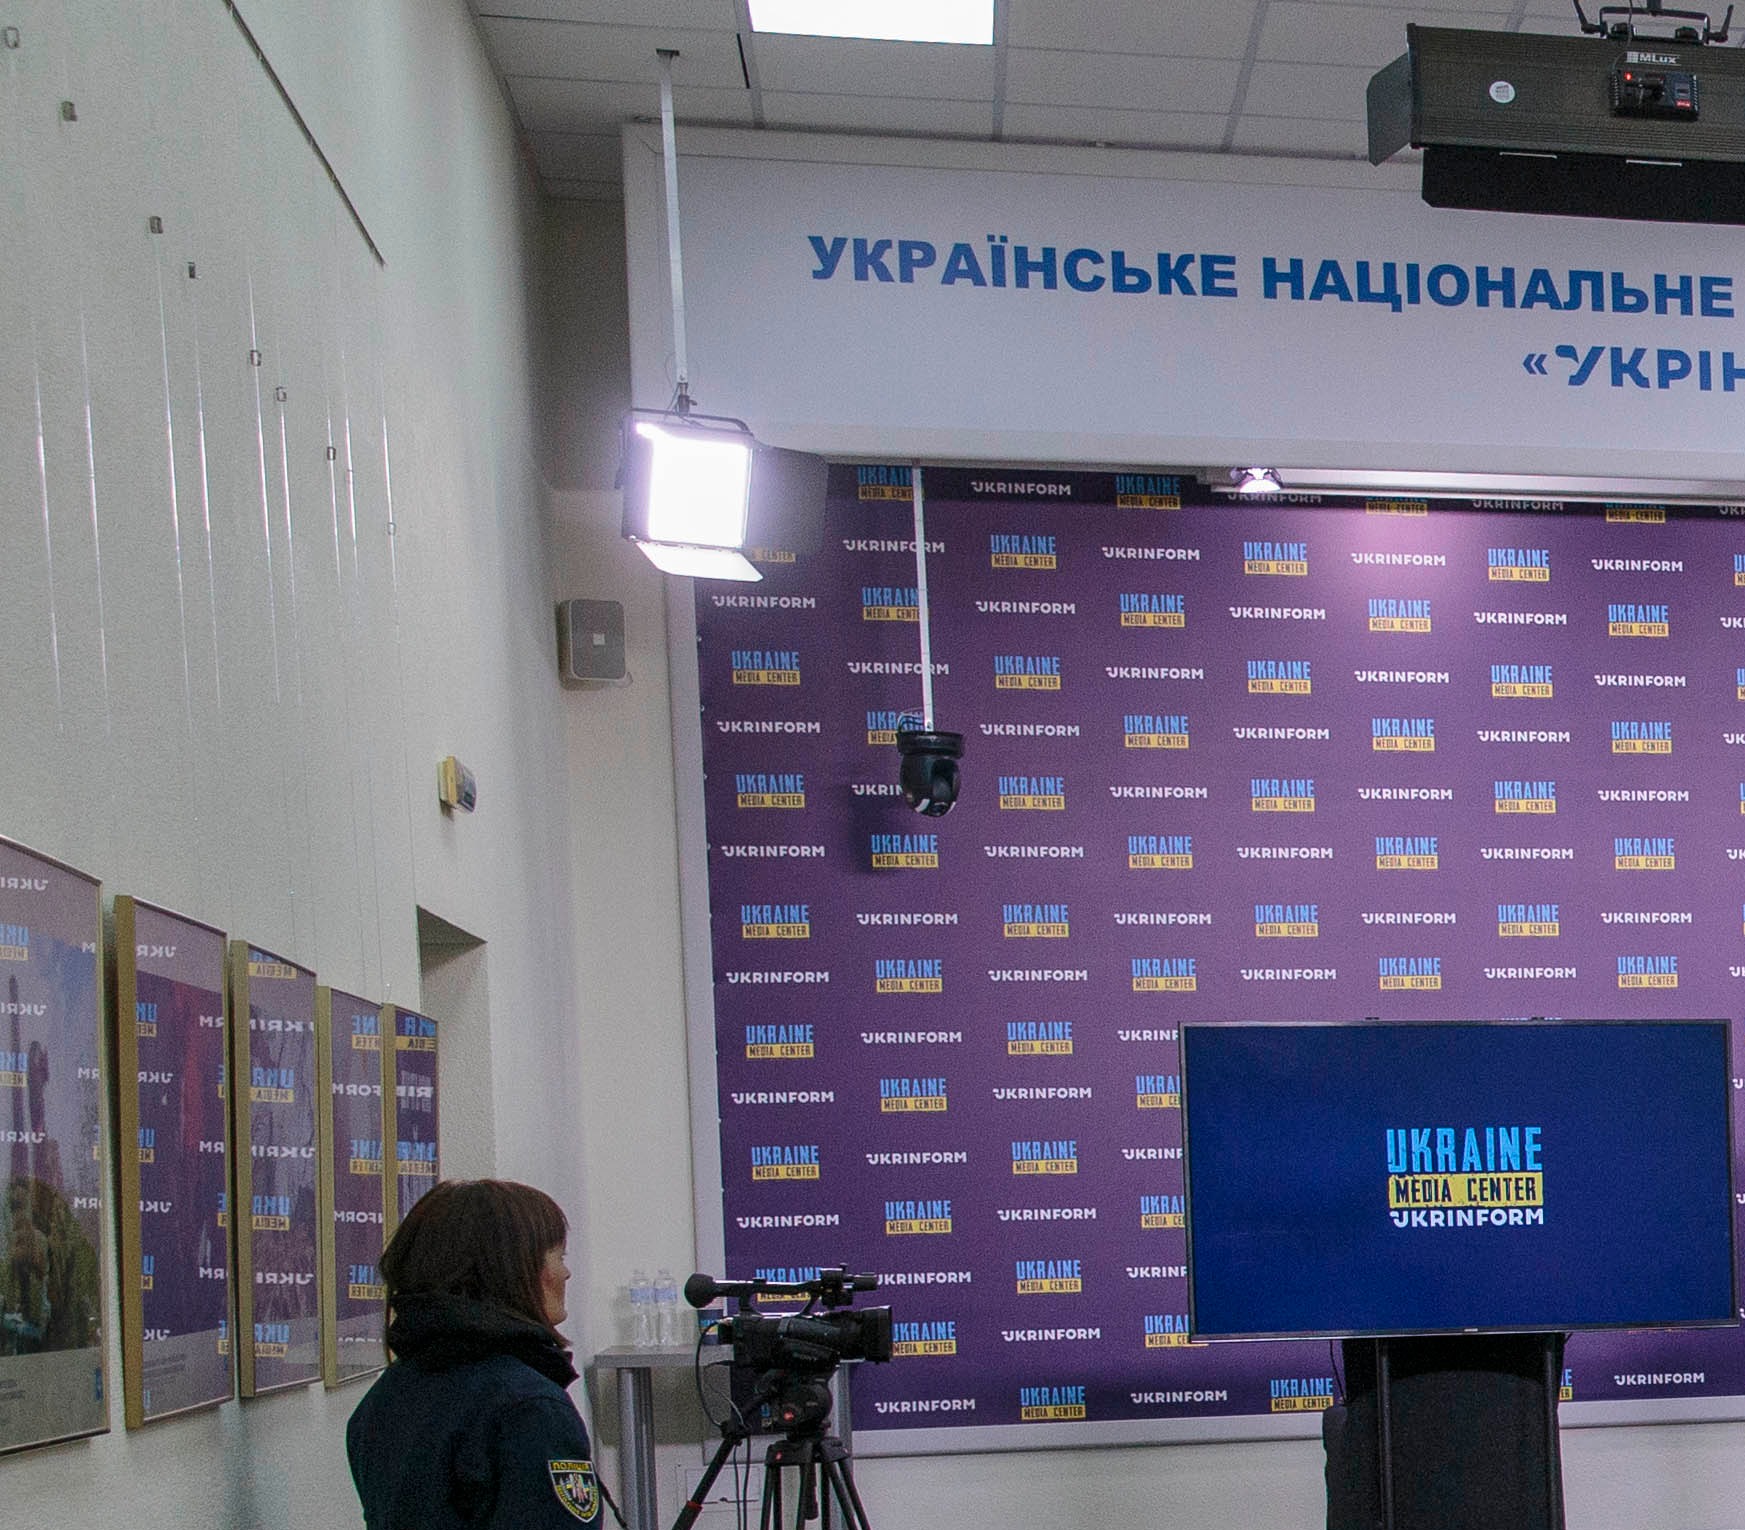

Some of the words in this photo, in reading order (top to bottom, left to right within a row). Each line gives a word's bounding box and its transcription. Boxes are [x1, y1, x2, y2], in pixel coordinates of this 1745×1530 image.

[808, 234, 1238, 298] УКРАЇНСЬКЕ
[1262, 256, 1734, 318] НАЦІОНАЛЬНЕ
[972, 482, 1070, 494] UKRINFORM
[992, 536, 1055, 552] UKRAINE
[1245, 543, 1306, 558] UKRAINE
[993, 552, 1018, 566] MEDIA
[1024, 553, 1054, 567] CENTER
[1102, 547, 1200, 560] UKRINFORM
[1352, 553, 1445, 565] UKRINFORM
[1491, 550, 1548, 564] UKRAINE
[1246, 558, 1270, 572] MEDIA
[1276, 559, 1305, 573] CENTER
[1491, 565, 1514, 579] MEDIA
[1519, 565, 1547, 580] CENTER
[712, 597, 815, 608] UKRINFORM
[976, 601, 1075, 614] UKRINFORM
[1229, 607, 1325, 619] UKRINFORM
[1474, 612, 1567, 624] UKRINFORM
[732, 652, 799, 668] UKRAINE
[735, 668, 761, 682] MEDIA
[766, 669, 798, 683] CENTER
[1106, 667, 1203, 679] UKRINFORM
[1594, 675, 1686, 686] UKRINFORM
[717, 721, 820, 733] UKRINFORM
[980, 724, 1080, 736] UKRINFORM
[1233, 728, 1329, 739] UKRINFORM
[1000, 778, 1064, 793] UKRAINE
[1253, 780, 1314, 795] UKRAINE
[1110, 787, 1207, 798] UKRINFORM
[1358, 788, 1452, 800] UKRINFORM
[1002, 793, 1027, 807] MEDIA
[1032, 794, 1063, 808] CENTER
[1254, 795, 1278, 809] MEDIA
[1284, 796, 1313, 810] CENTER
[721, 845, 825, 857] UKRINFORM
[984, 846, 1083, 857] UKRINFORM
[1617, 839, 1674, 852] UKRAINE
[1237, 847, 1333, 858] UKRINFORM
[1481, 848, 1573, 859] UKRINFORM
[1617, 853, 1640, 867] MEDIA
[1645, 853, 1673, 868] CENTER
[742, 905, 809, 923] UKRAINE
[856, 913, 958, 925] UKRINFORM
[1114, 913, 1211, 924] UKRINFORM
[1362, 913, 1456, 924] UKRINFORM
[1601, 912, 1692, 923] UKRINFORM
[744, 923, 770, 936] MEDIA
[776, 924, 808, 936] CENTER
[1380, 959, 1440, 974] UKRAINE
[1484, 967, 1576, 978] UKRINFORM
[726, 971, 829, 984] UKRINFORM
[988, 970, 1087, 981] UKRINFORM
[1241, 969, 1336, 980] UKRINFORM
[1382, 974, 1405, 988] MEDIA
[1410, 975, 1439, 988] CENTER
[1008, 1022, 1072, 1038] UKRAINE
[861, 1032, 962, 1044] UKRINFORM
[1010, 1038, 1035, 1052] MEDIA
[1040, 1039, 1071, 1053] CENTER
[731, 1091, 834, 1104] UKRINFORM
[752, 1146, 819, 1163] UKRAINE
[1386, 1127, 1543, 1173] UKRAINE
[866, 1152, 967, 1165] UKRINFORM
[754, 1163, 780, 1177] MEDIA
[786, 1164, 818, 1178] CENTER
[1395, 1179, 1452, 1203] MEDIA
[1467, 1177, 1536, 1201] CENTER
[736, 1214, 839, 1228] UKRINFORM
[997, 1208, 1096, 1221] UKRINFORM
[1389, 1208, 1544, 1228] UKRINFORM
[1002, 1328, 1100, 1342] UKRINFORM
[1614, 1373, 1705, 1385] UKRINFORM
[1271, 1378, 1332, 1398] UKRAINE
[1021, 1386, 1084, 1407] UKRAINE
[1131, 1390, 1227, 1403] UKRINFORM
[875, 1399, 975, 1413] UKRINFORM
[1273, 1398, 1297, 1409] MEDIA
[1302, 1398, 1331, 1409] CENTER
[1024, 1407, 1048, 1418] MEDIA
[1054, 1407, 1083, 1418] CENTER
